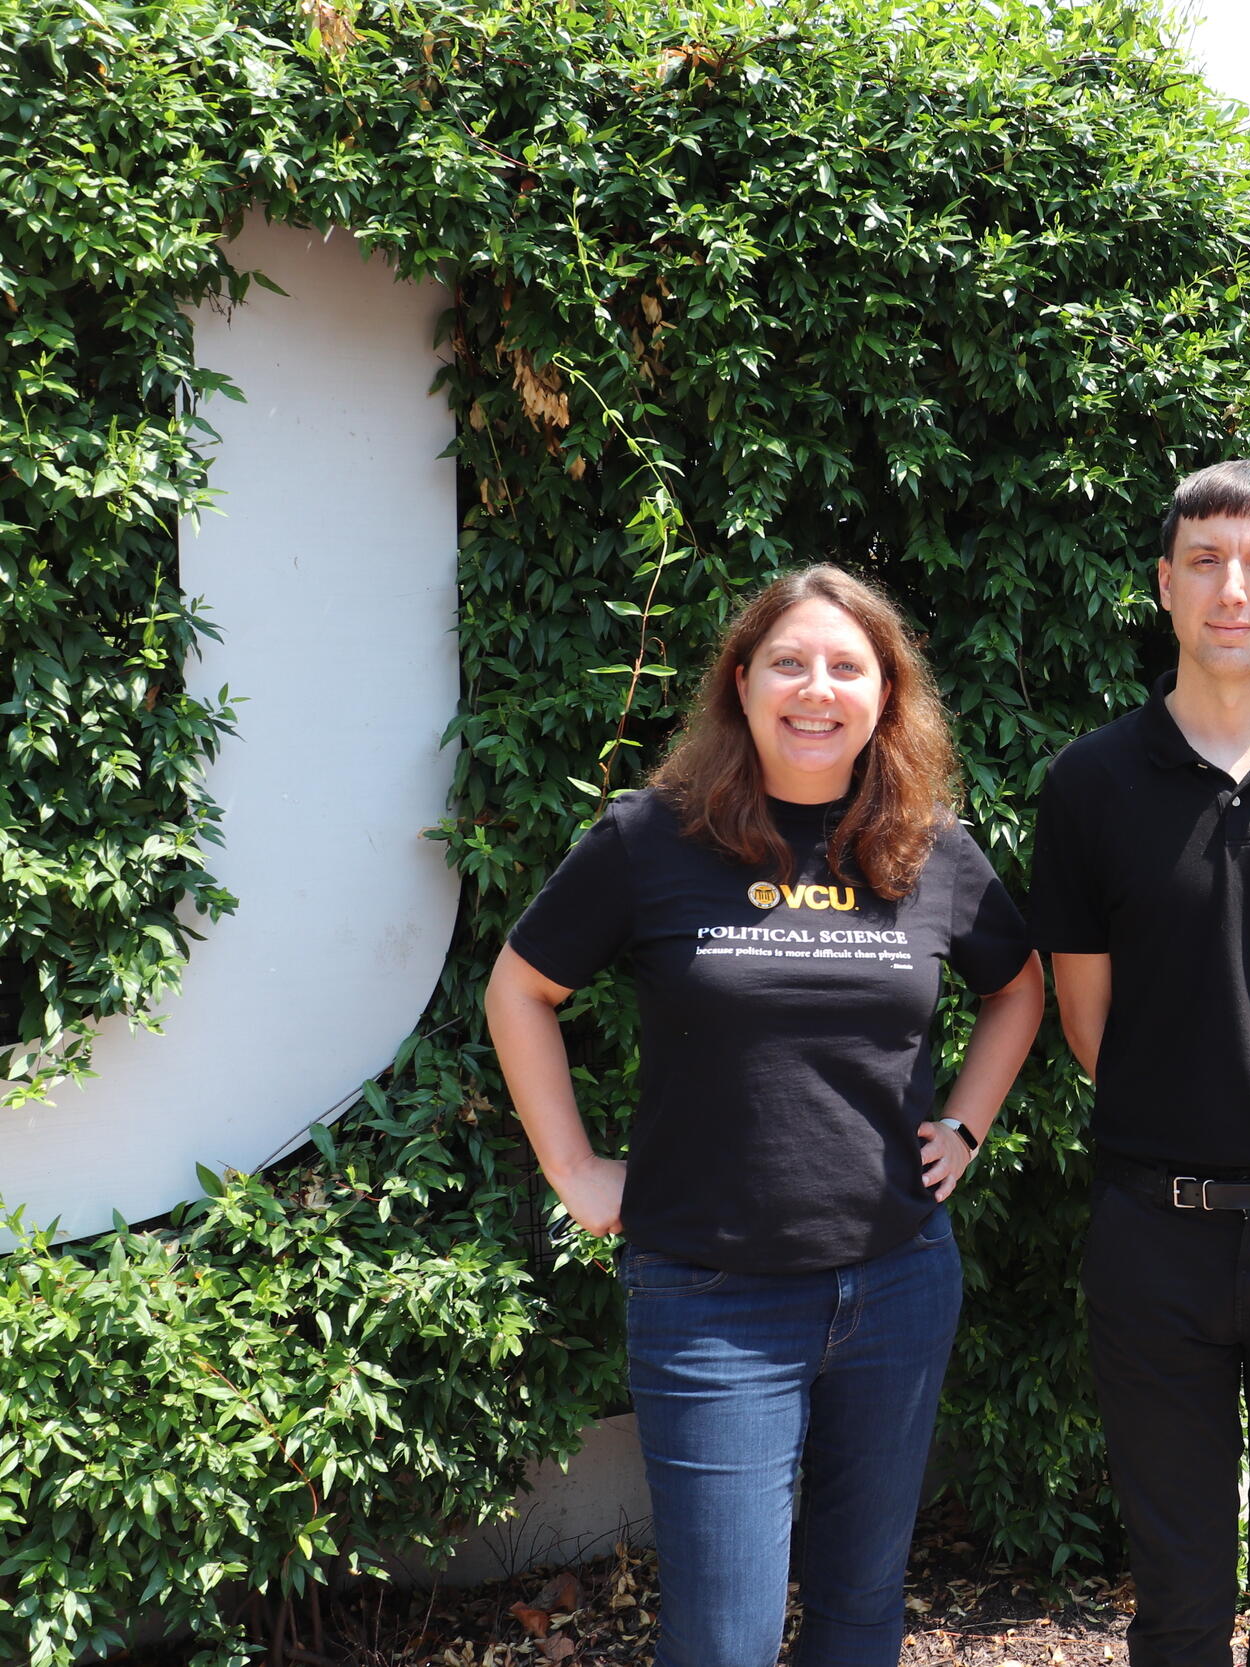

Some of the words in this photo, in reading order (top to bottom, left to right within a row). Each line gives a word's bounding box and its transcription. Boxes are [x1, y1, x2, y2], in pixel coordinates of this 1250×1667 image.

[780, 884, 856, 911] VCU
[697, 926, 815, 943] POLITICAL
[819, 930, 908, 945] SCIENCE
[696, 946, 734, 956] because
[735, 946, 773, 957] politics
[774, 948, 783, 957] is
[785, 950, 811, 959] more
[812, 948, 852, 960] difficult
[854, 949, 877, 960] than
[878, 950, 912, 962] physics
